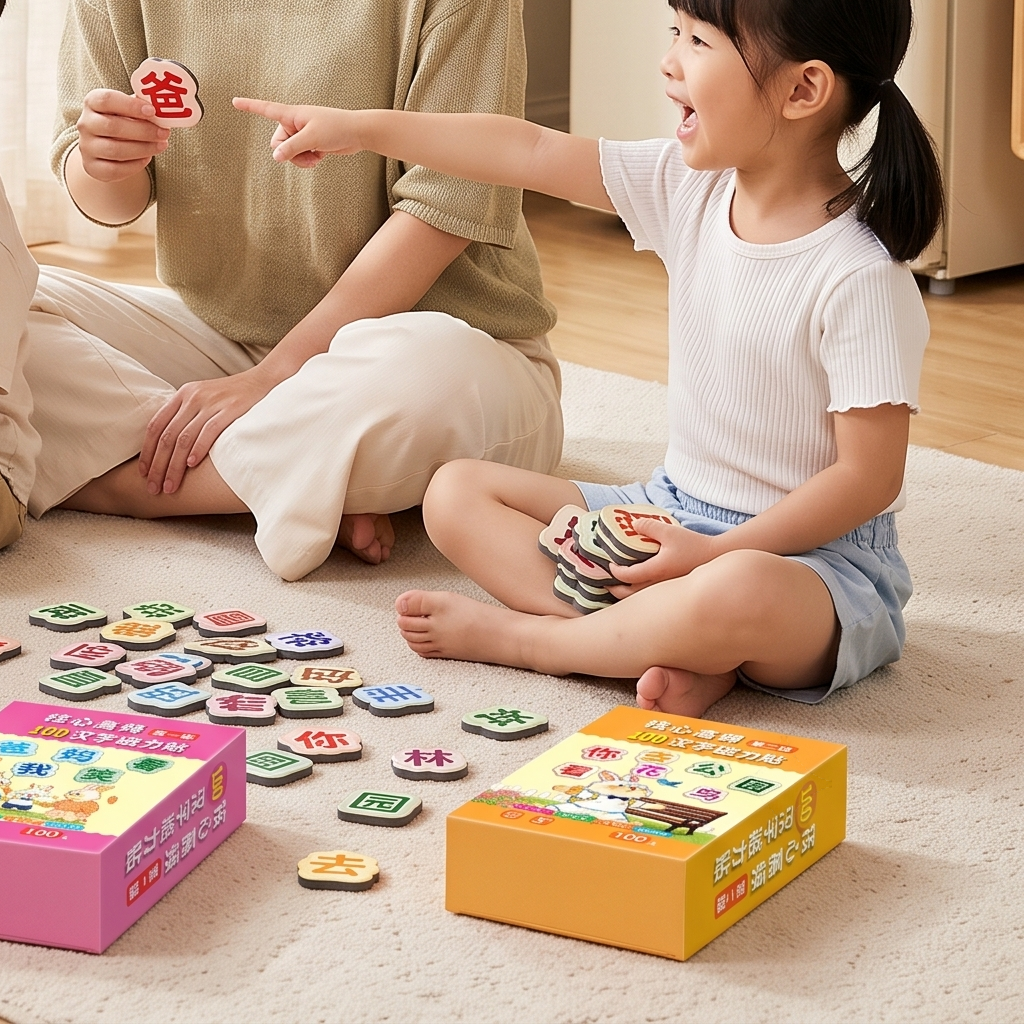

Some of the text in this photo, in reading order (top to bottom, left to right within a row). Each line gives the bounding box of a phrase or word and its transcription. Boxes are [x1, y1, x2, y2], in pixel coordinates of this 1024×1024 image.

[140, 71, 193, 118] 爸
[294, 730, 349, 751] 你
[404, 749, 454, 767] 林
[17, 762, 53, 777] 我
[348, 791, 412, 813] 园
[25, 827, 60, 838] 100
[614, 831, 648, 843] 100
[309, 854, 367, 877] 去
